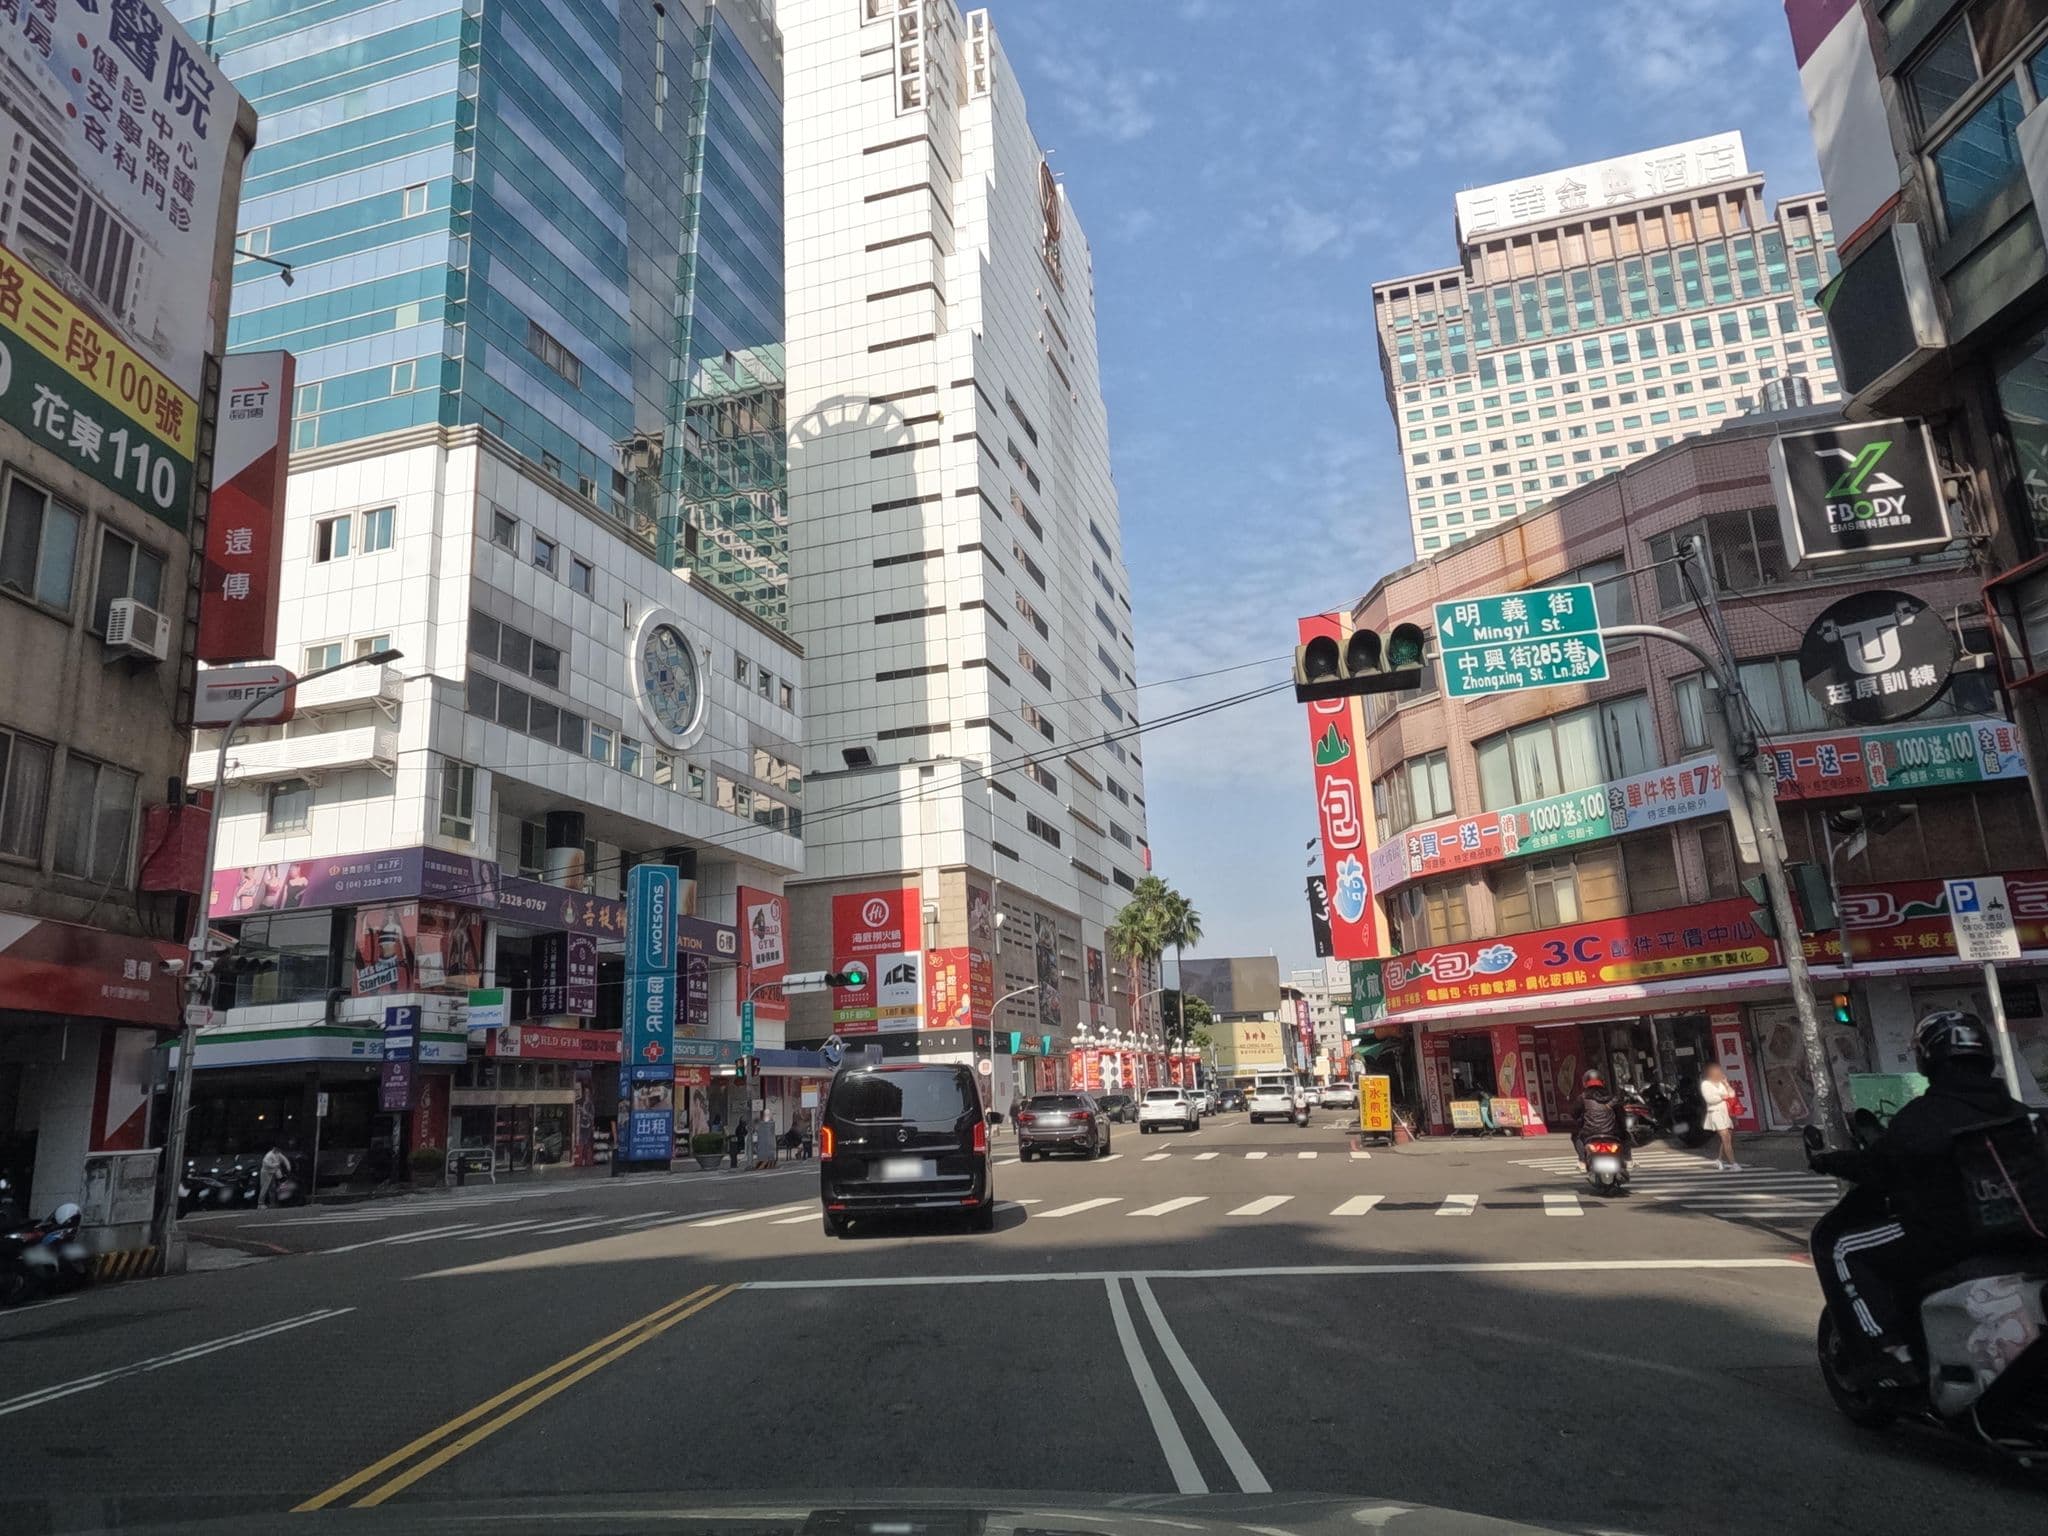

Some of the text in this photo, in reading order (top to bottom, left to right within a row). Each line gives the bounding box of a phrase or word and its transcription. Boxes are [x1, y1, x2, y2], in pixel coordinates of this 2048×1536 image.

[92, 45, 198, 170] 健診中心
[230, 392, 268, 408] FET
[1826, 495, 1906, 524] FBODY
[222, 528, 252, 601] 遠傳
[1455, 592, 1574, 628] 明義街
[1474, 618, 1566, 641] Mingyi St.
[1458, 637, 1587, 676] 中興街285巷
[1462, 671, 1524, 690] Zhongxing
[1530, 667, 1547, 681] St.
[1776, 744, 1861, 783] 買一送一
[1868, 740, 1888, 787] 消費
[1977, 728, 2000, 775] 全館
[1609, 789, 1630, 829] 全館
[1408, 836, 1423, 873] 全館
[1422, 824, 1500, 859] 買一送一
[500, 893, 547, 911] 2328-0767
[1953, 885, 1974, 911] P
[651, 885, 664, 955] watsons
[1542, 935, 1603, 967] 3C
[883, 964, 918, 986] ACE
[397, 1008, 411, 1026] P
[637, 1118, 666, 1135] 出租
